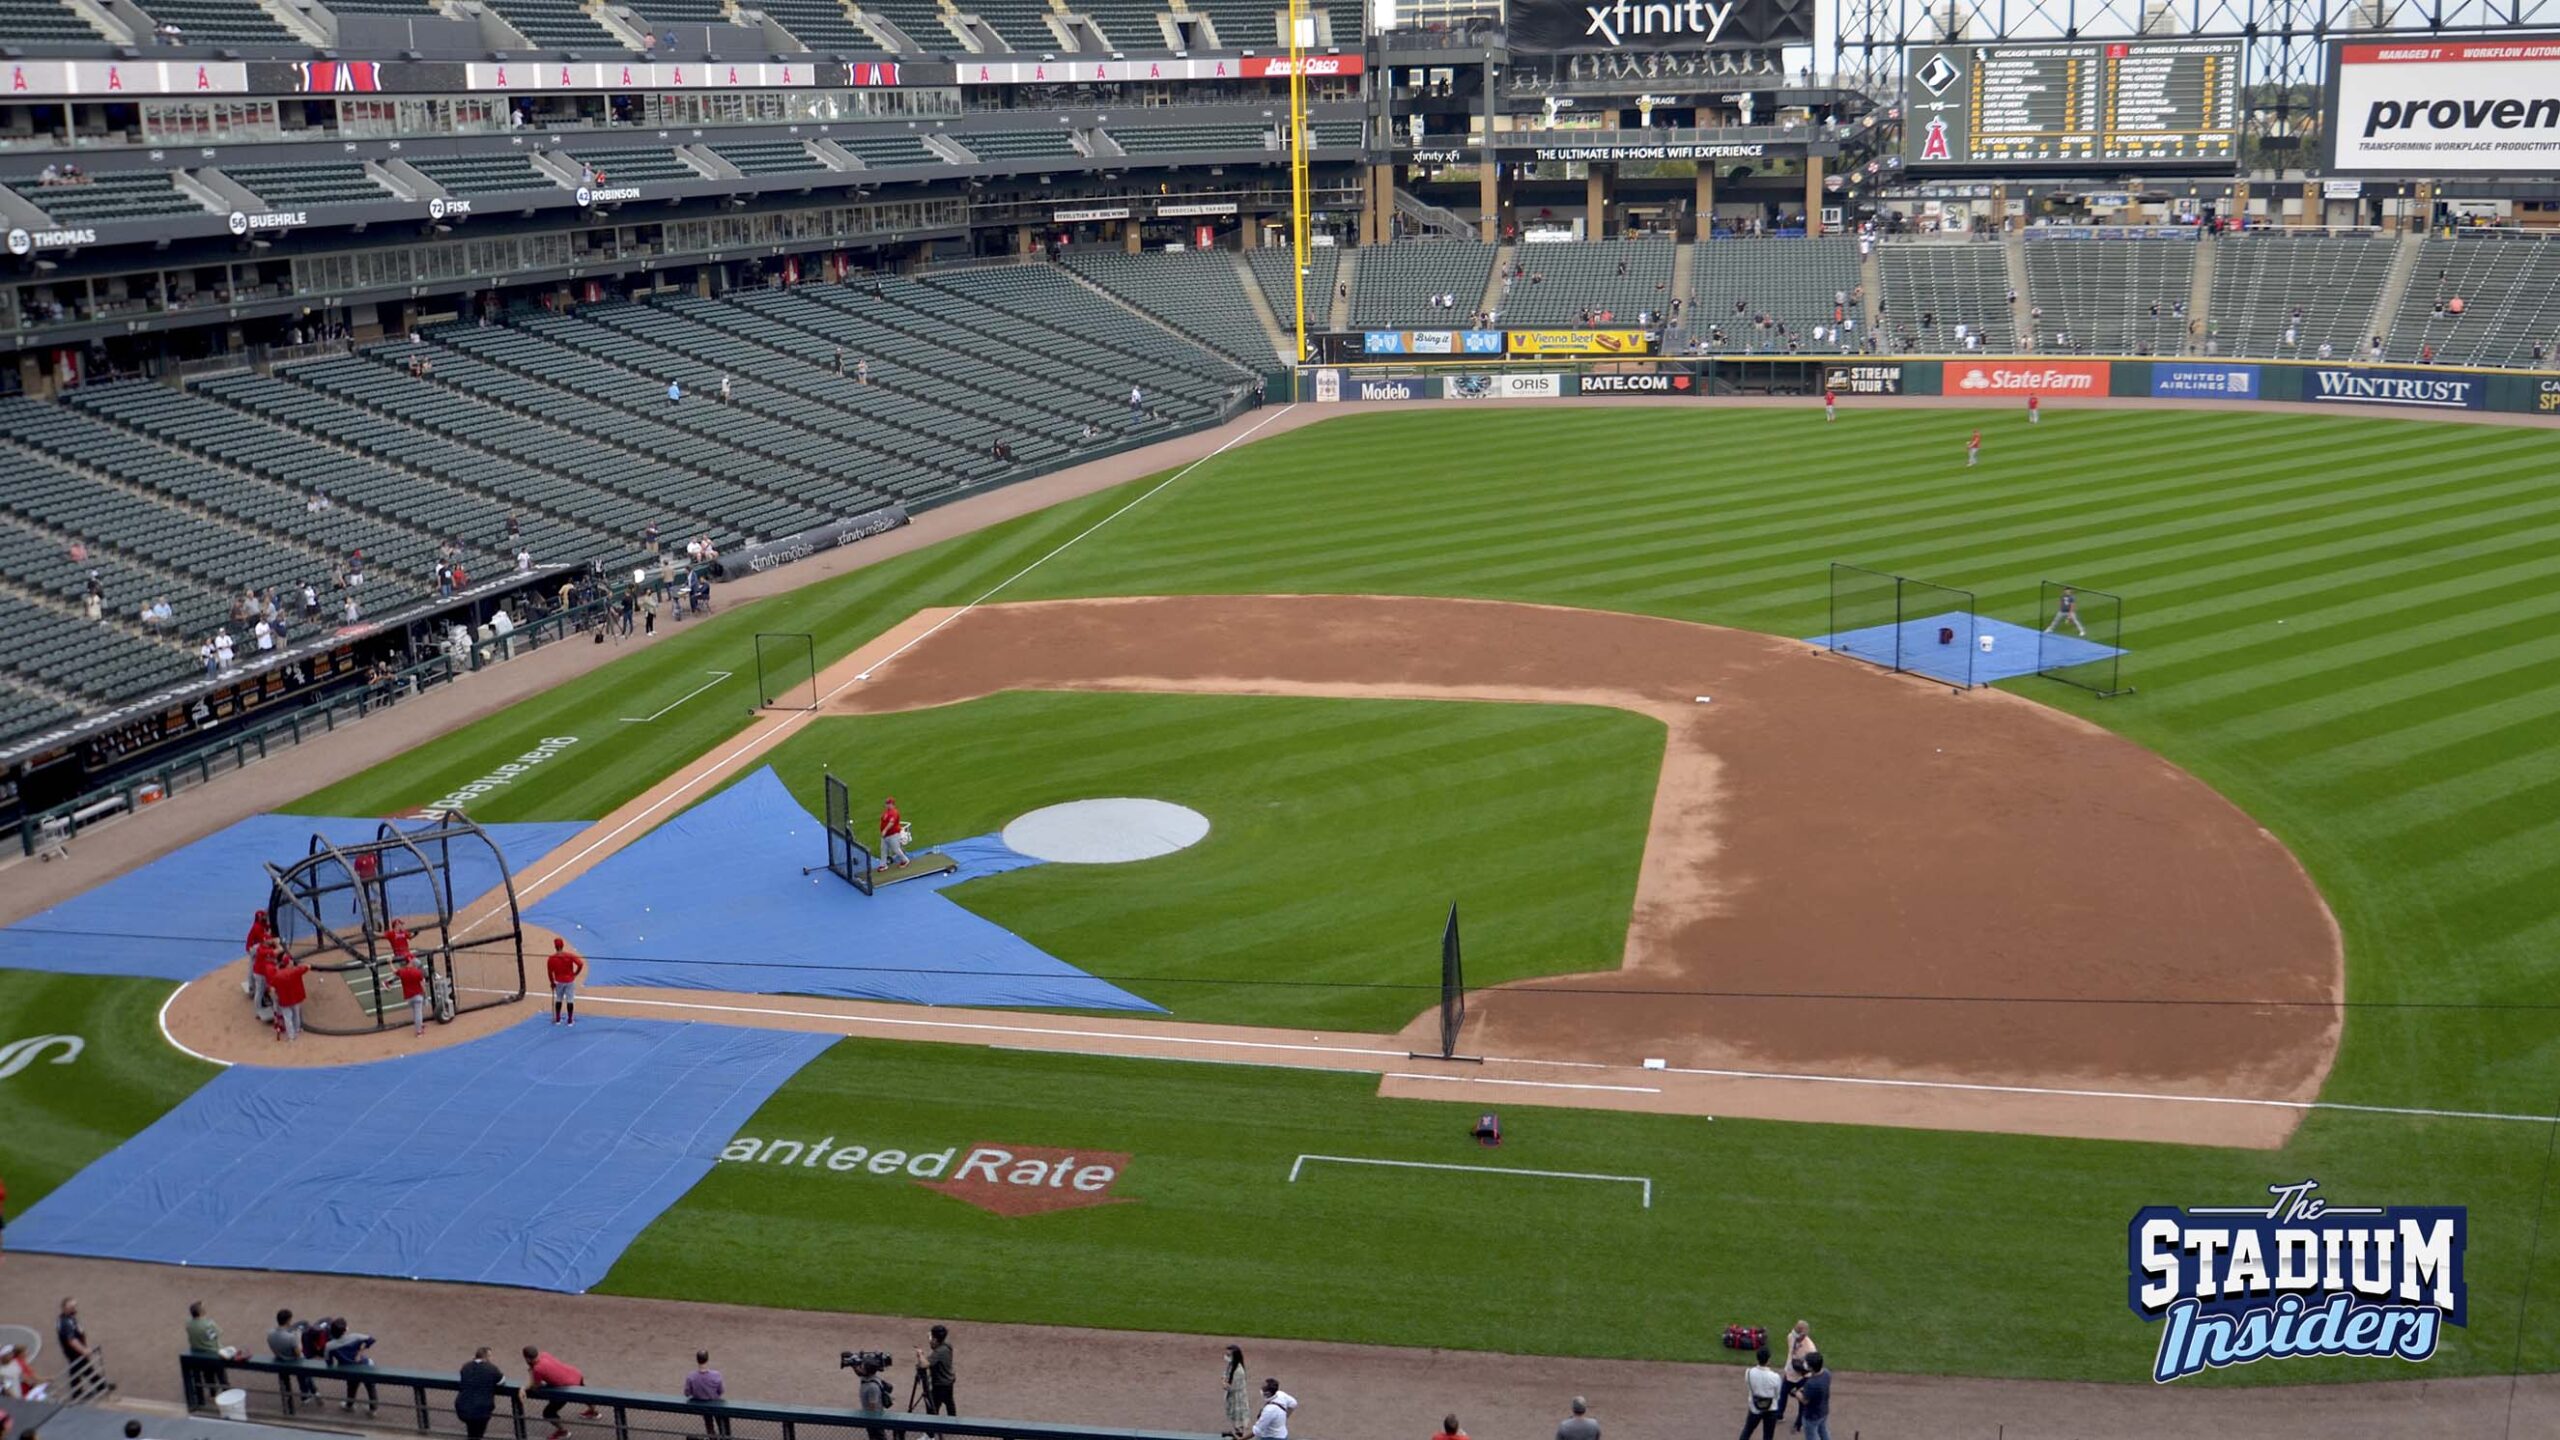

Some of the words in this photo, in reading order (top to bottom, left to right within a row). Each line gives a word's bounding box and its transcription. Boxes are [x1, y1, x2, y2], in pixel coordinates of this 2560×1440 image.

[1585, 0, 1733, 45] xfinity
[2377, 49, 2429, 60] MANAGED
[2430, 49, 2442, 59] IT
[2463, 48, 2523, 58] WORKFLOW
[1635, 96, 1676, 105] CERAGE
[1930, 102, 1945, 111] VS
[2363, 99, 2560, 138] proven
[1536, 149, 1555, 160] THE
[1557, 149, 1609, 160] ULTIMATE
[1611, 148, 1664, 159] IN-HOME
[1667, 147, 1693, 158] WIFI
[1695, 145, 1763, 158] EXPERIENCE
[2358, 142, 2432, 151] TRANSFORMING
[2434, 142, 2493, 151] WORKPLACE
[1413, 150, 1444, 163] xfinity
[1445, 150, 1460, 163] xFi
[591, 188, 640, 202] ROBINSON
[431, 203, 443, 214] 72
[446, 200, 471, 213] FISK
[231, 217, 245, 228] 56
[250, 212, 307, 228] BUEHRLE
[32, 229, 96, 247] THOMAS
[1415, 333, 1441, 345] Bring
[1442, 334, 1449, 343] it
[1531, 333, 1568, 343] Vienna
[1570, 332, 1595, 343] Beef
[1851, 367, 1900, 380] STREAM
[2173, 372, 2225, 382] UNITED
[1512, 378, 1549, 390] ORIS
[1581, 376, 1668, 391] RATE.COM
[1851, 380, 1882, 393] YOUR
[2160, 381, 2225, 391] AIRLINES
[2315, 371, 2471, 402] WINTRUST
[1361, 382, 1410, 400] Modelo
[837, 526, 866, 546] xfinity
[865, 516, 896, 536] mobile
[749, 551, 782, 573] xfinity
[781, 542, 815, 564] mobile
[428, 736, 578, 809] guaranteed
[719, 1136, 956, 1178] anteed
[954, 1148, 1115, 1192] Rate
